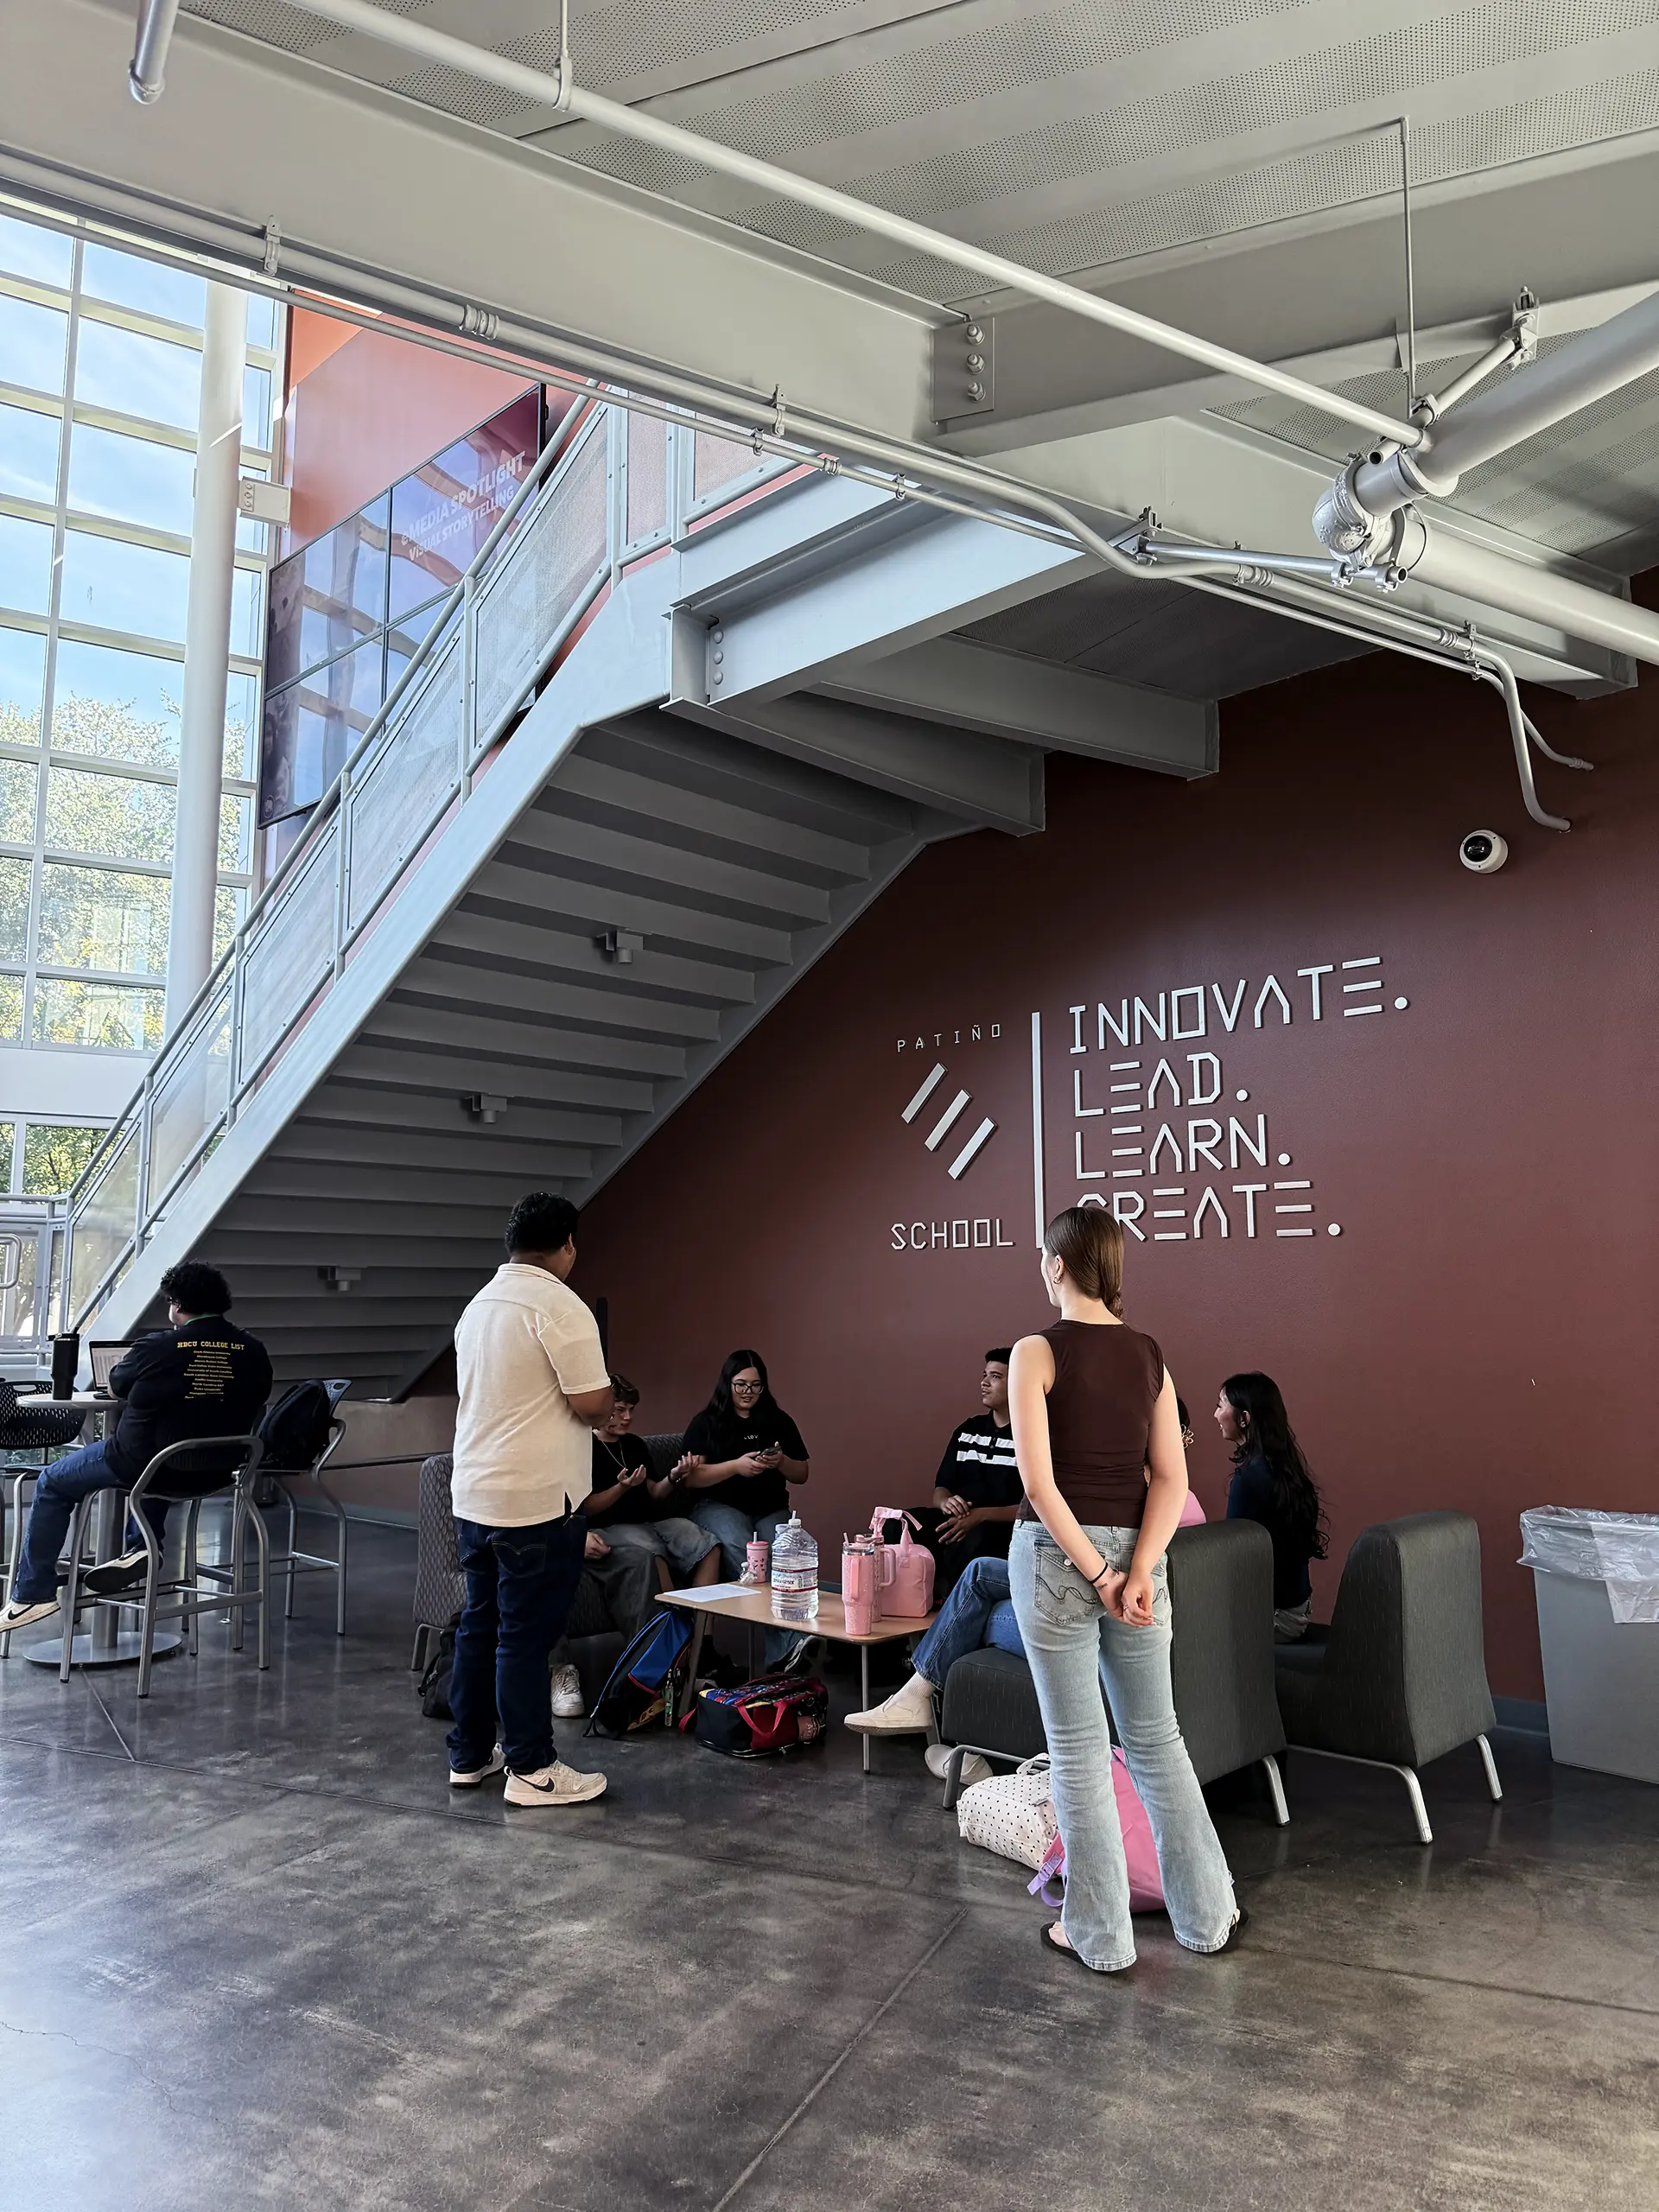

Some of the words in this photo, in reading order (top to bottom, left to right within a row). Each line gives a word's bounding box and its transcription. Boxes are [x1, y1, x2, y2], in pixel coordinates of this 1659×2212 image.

[401, 505, 450, 546] eMEDIA
[450, 450, 525, 515] SPOTLIGHT
[409, 530, 442, 561] VISUAL
[896, 1024, 1001, 1053] PATIÑO
[1069, 956, 1409, 1055] INNOVATE.
[1073, 1051, 1249, 1118] LEAD.
[1075, 1113, 1291, 1179] LEARN.
[890, 1217, 1014, 1250] SCHOOL
